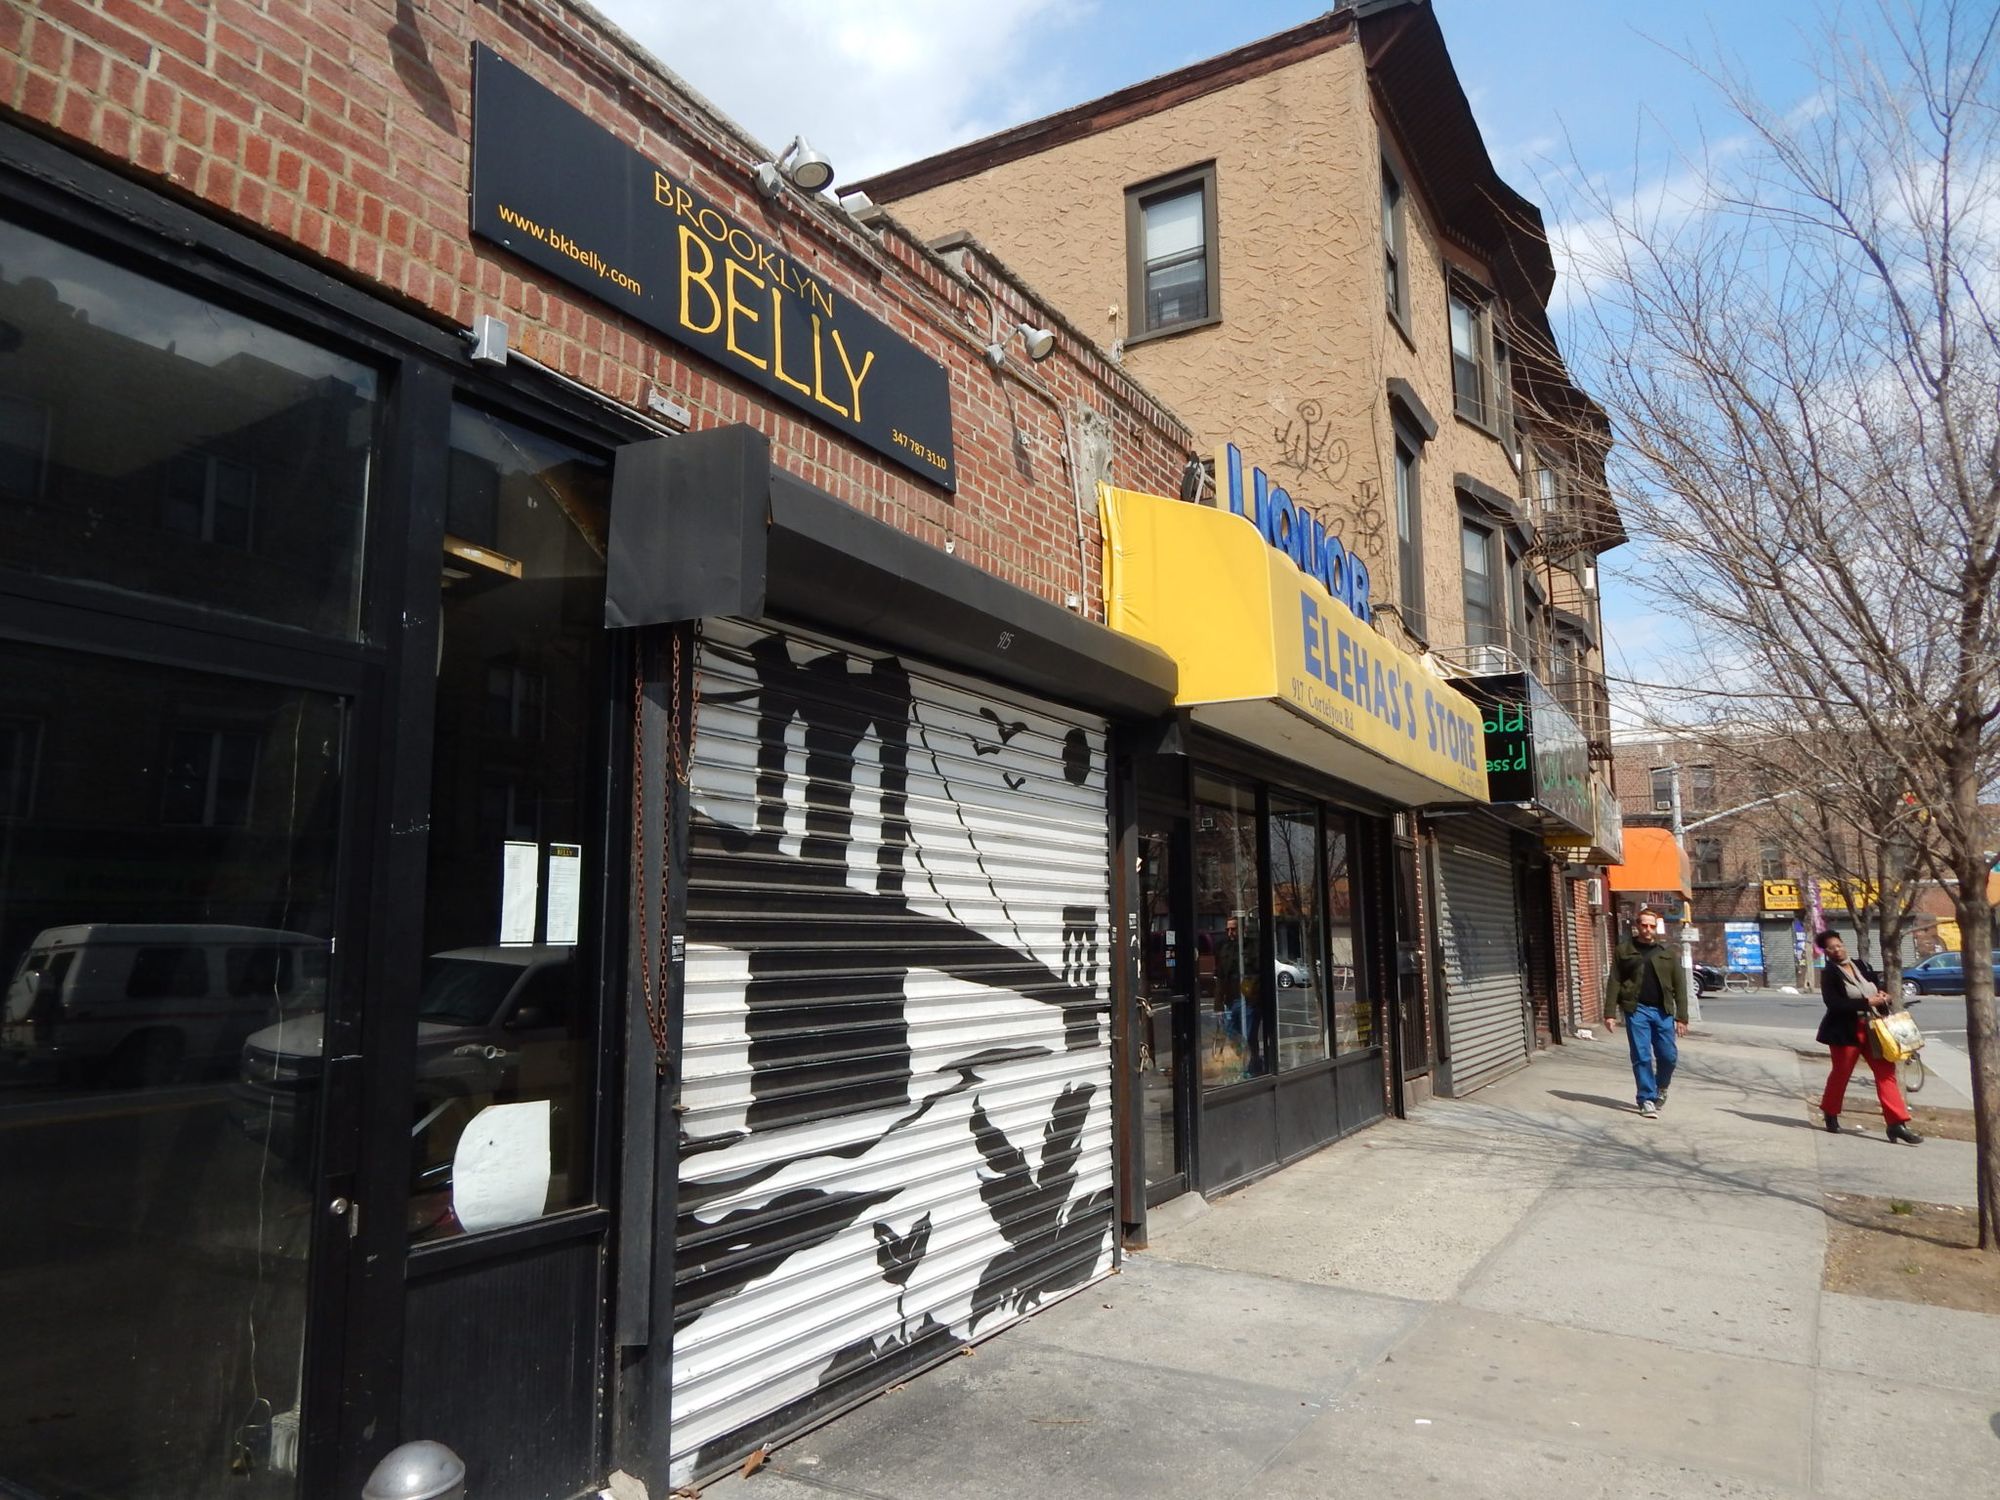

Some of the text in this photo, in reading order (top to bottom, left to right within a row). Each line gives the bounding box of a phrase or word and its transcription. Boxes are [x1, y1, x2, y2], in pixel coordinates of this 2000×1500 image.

[498, 202, 642, 296] www.bkbelly.com
[653, 170, 834, 318] BROOKLYN
[677, 224, 875, 423] BELLY
[892, 429, 947, 470] 347 787 3110
[996, 631, 1015, 650] 915
[1291, 677, 1355, 731] 917 Cortelyou Rd
[1299, 590, 1478, 771] ELEHAS'S STORE
[1482, 702, 1523, 734] old
